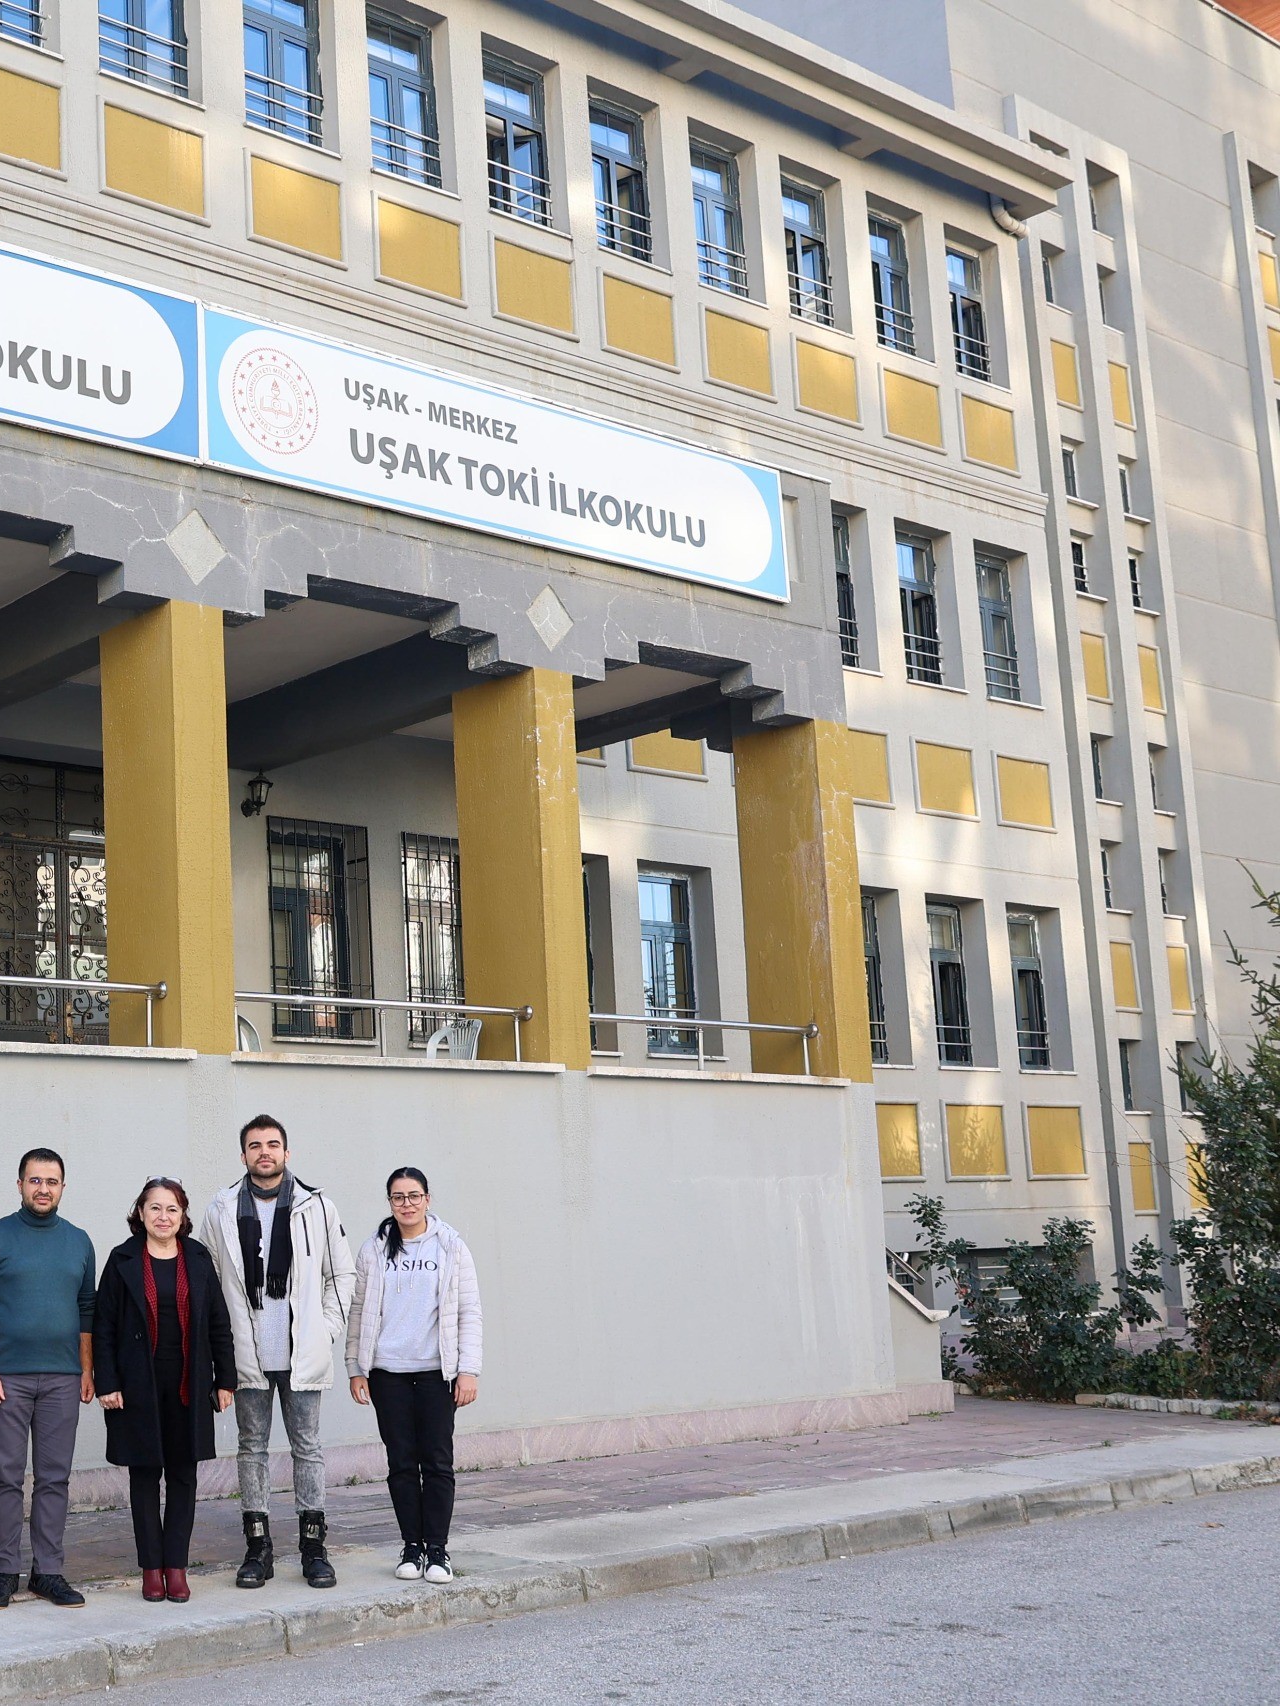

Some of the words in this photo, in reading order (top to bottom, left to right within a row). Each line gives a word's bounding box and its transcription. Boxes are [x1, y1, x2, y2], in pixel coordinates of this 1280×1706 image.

[345, 378, 410, 415] UŞAK
[429, 402, 518, 444] MERKEZ
[350, 428, 452, 486] UŞAK
[458, 457, 540, 507] TOKİ
[549, 472, 706, 548] İLKOKULU
